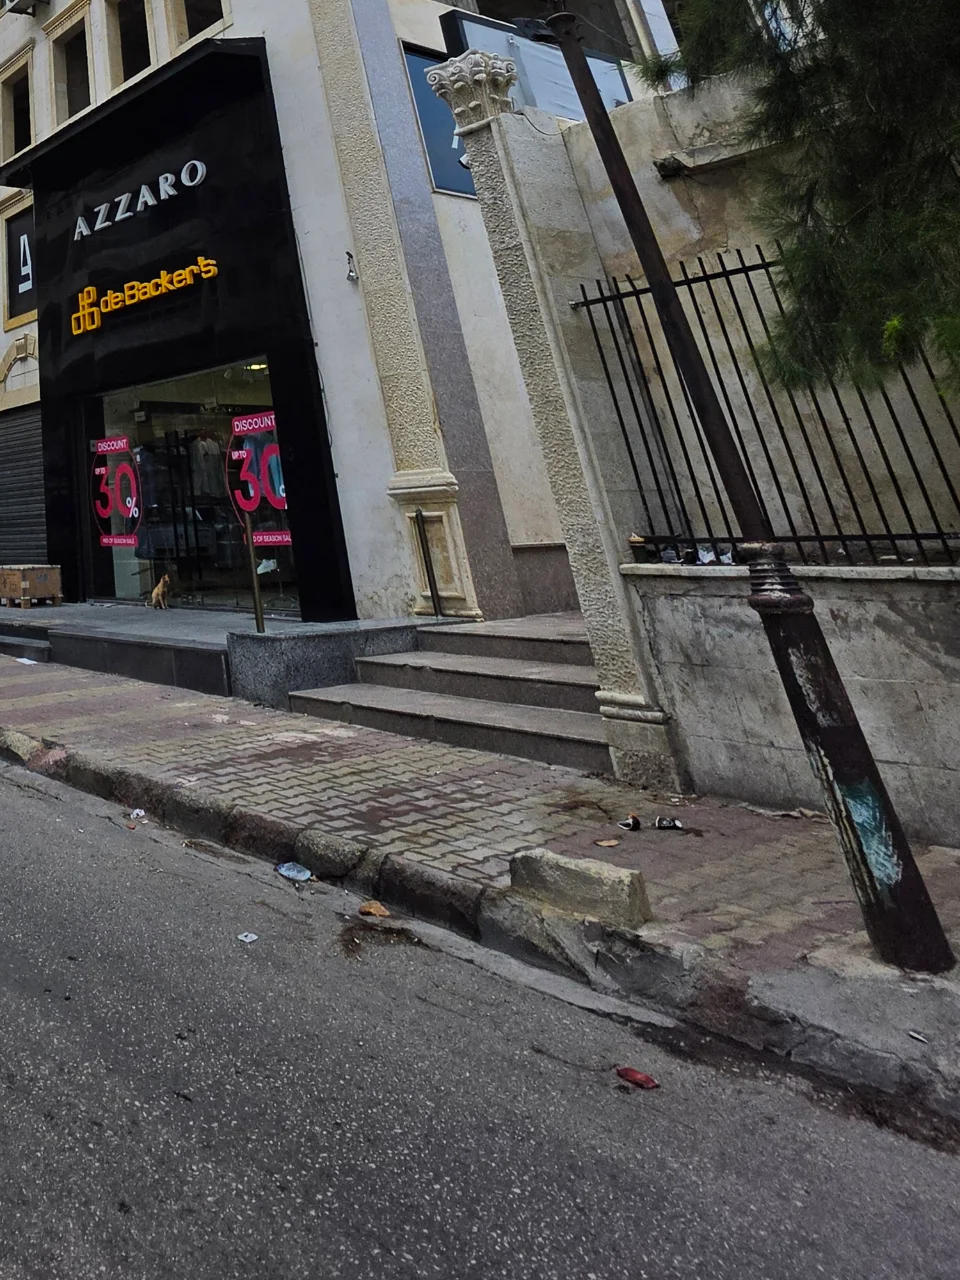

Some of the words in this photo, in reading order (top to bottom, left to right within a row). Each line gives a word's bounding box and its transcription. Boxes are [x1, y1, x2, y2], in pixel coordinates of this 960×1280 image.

[73, 159, 207, 241] AZZARO
[234, 415, 276, 432] DISCOUNT
[97, 439, 127, 452] DISCOUNT
